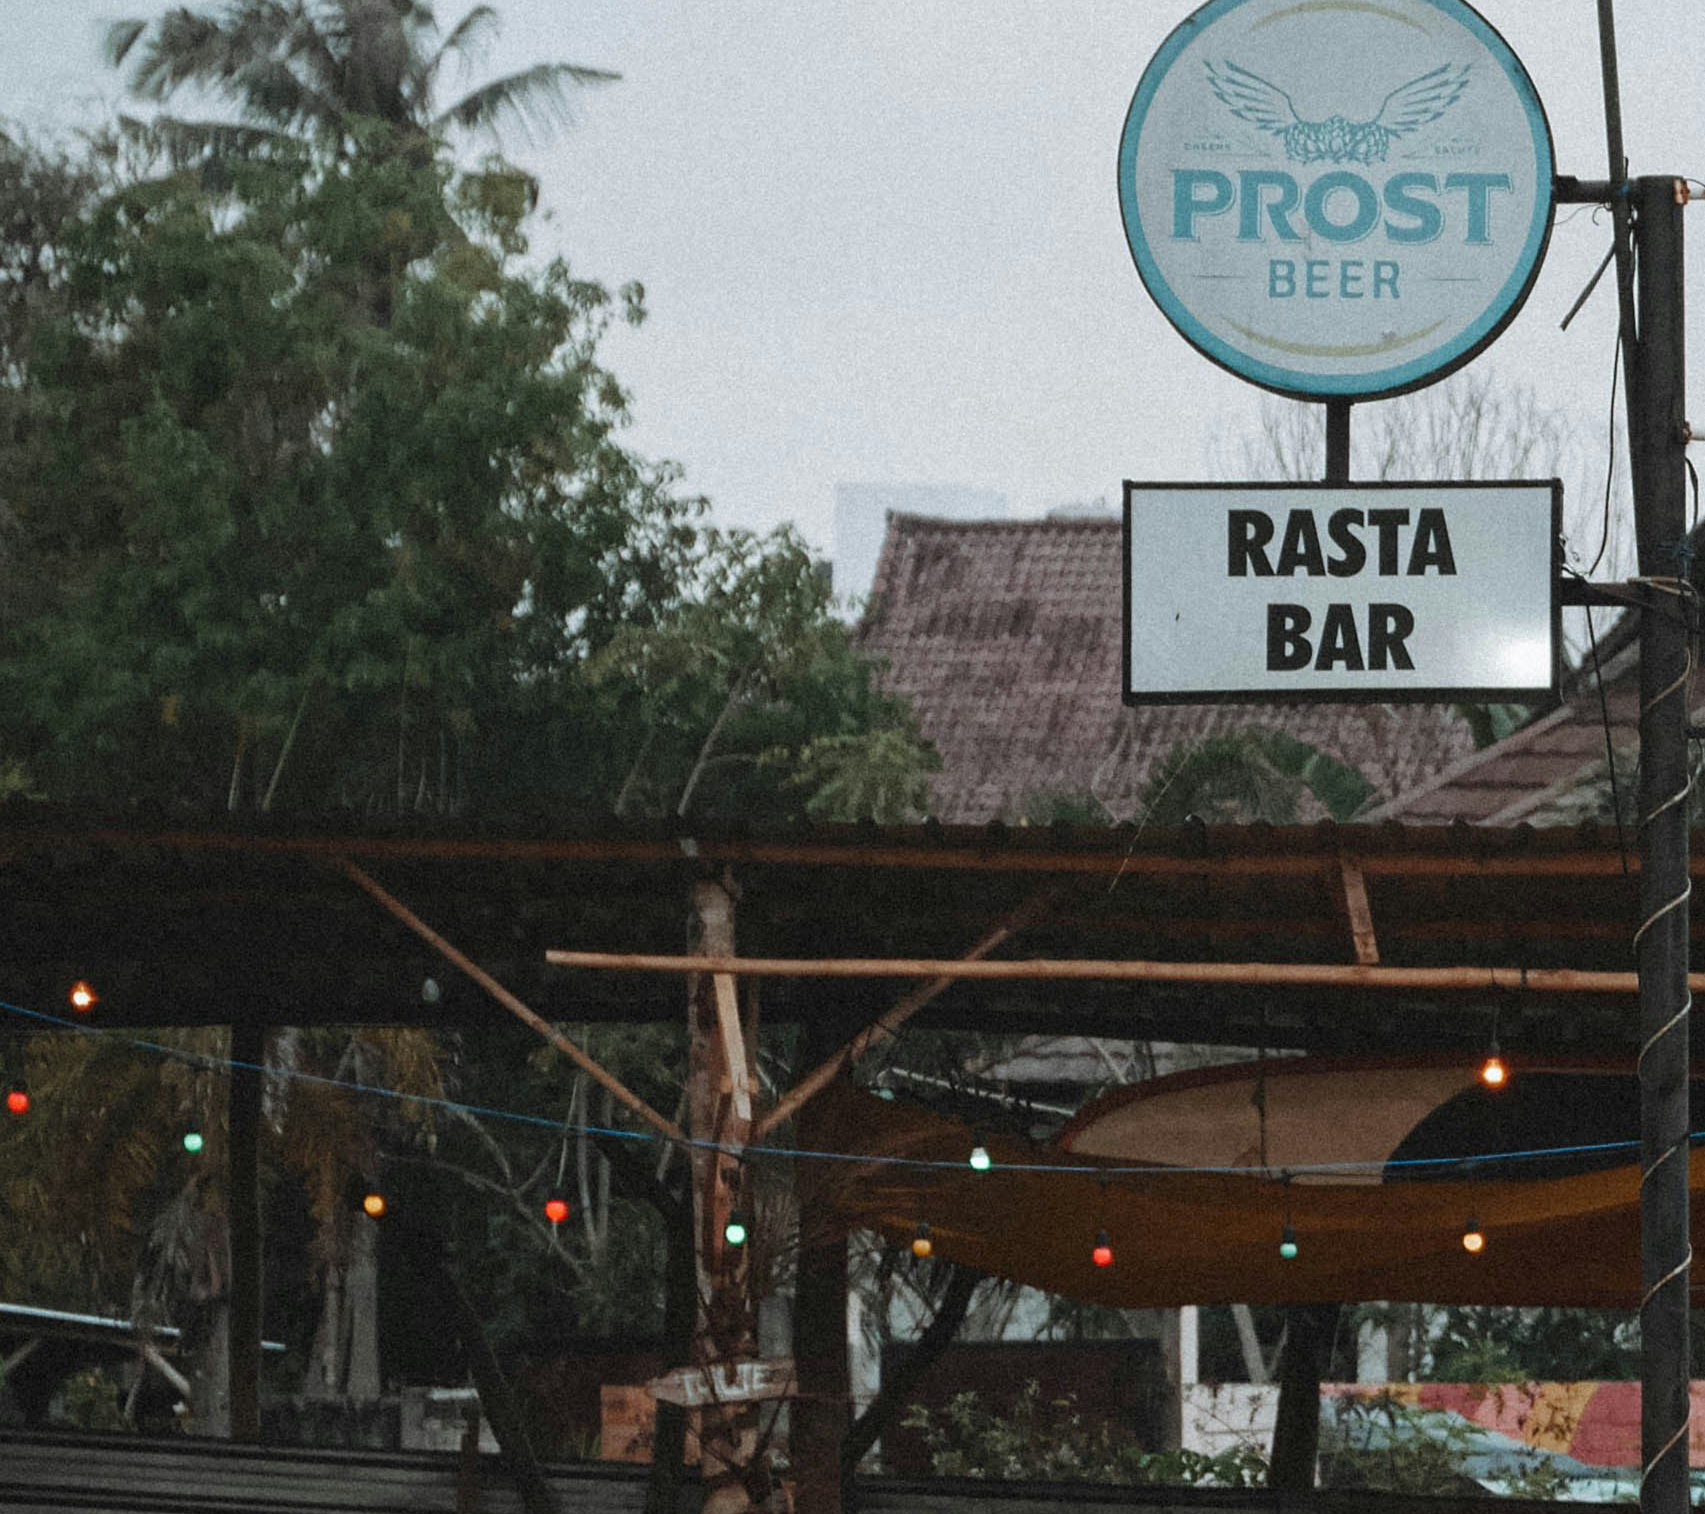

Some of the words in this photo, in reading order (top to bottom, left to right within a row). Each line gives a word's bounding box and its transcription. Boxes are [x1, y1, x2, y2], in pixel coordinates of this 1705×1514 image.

[1169, 168, 1513, 247] PROST
[1268, 259, 1401, 299] BEER
[1228, 508, 1457, 578] RASTA
[1266, 603, 1415, 671] BAR
